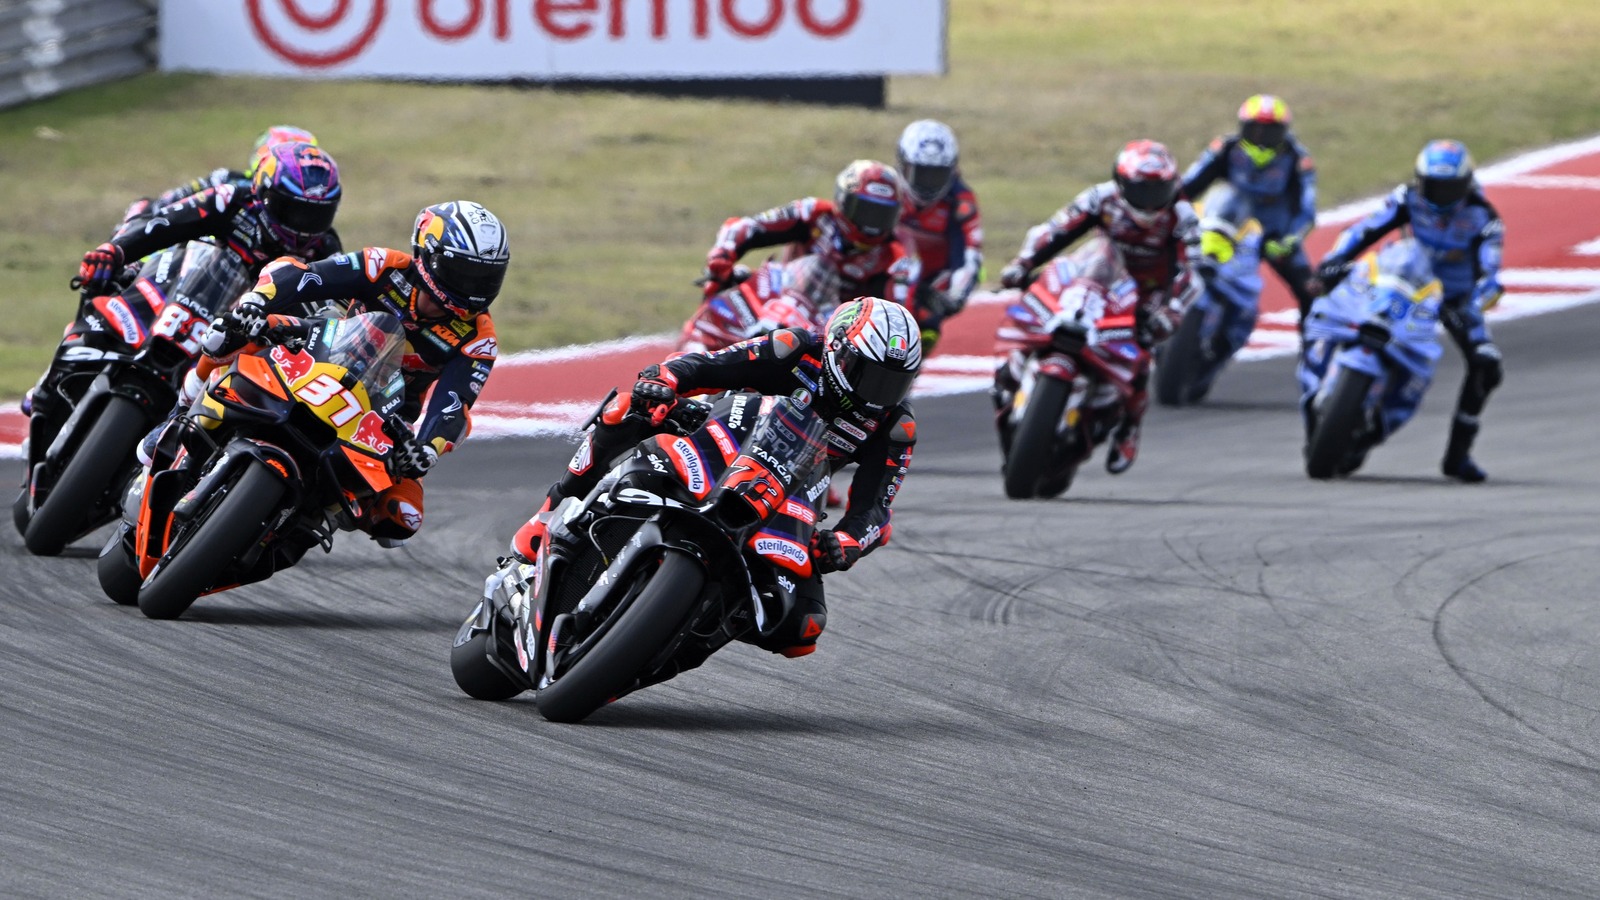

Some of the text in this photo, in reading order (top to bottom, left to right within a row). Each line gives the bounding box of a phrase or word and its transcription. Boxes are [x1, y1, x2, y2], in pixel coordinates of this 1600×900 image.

[85, 315, 105, 331] sky
[430, 324, 461, 347] KTM
[294, 372, 365, 429] 37
[840, 421, 866, 440] Castrol
[647, 453, 669, 474] sky
[676, 441, 701, 490] sterilgarda
[752, 445, 792, 485] TARGA
[786, 502, 815, 522] BS
[757, 541, 805, 562] sterilgarda
[778, 575, 796, 594] sky
